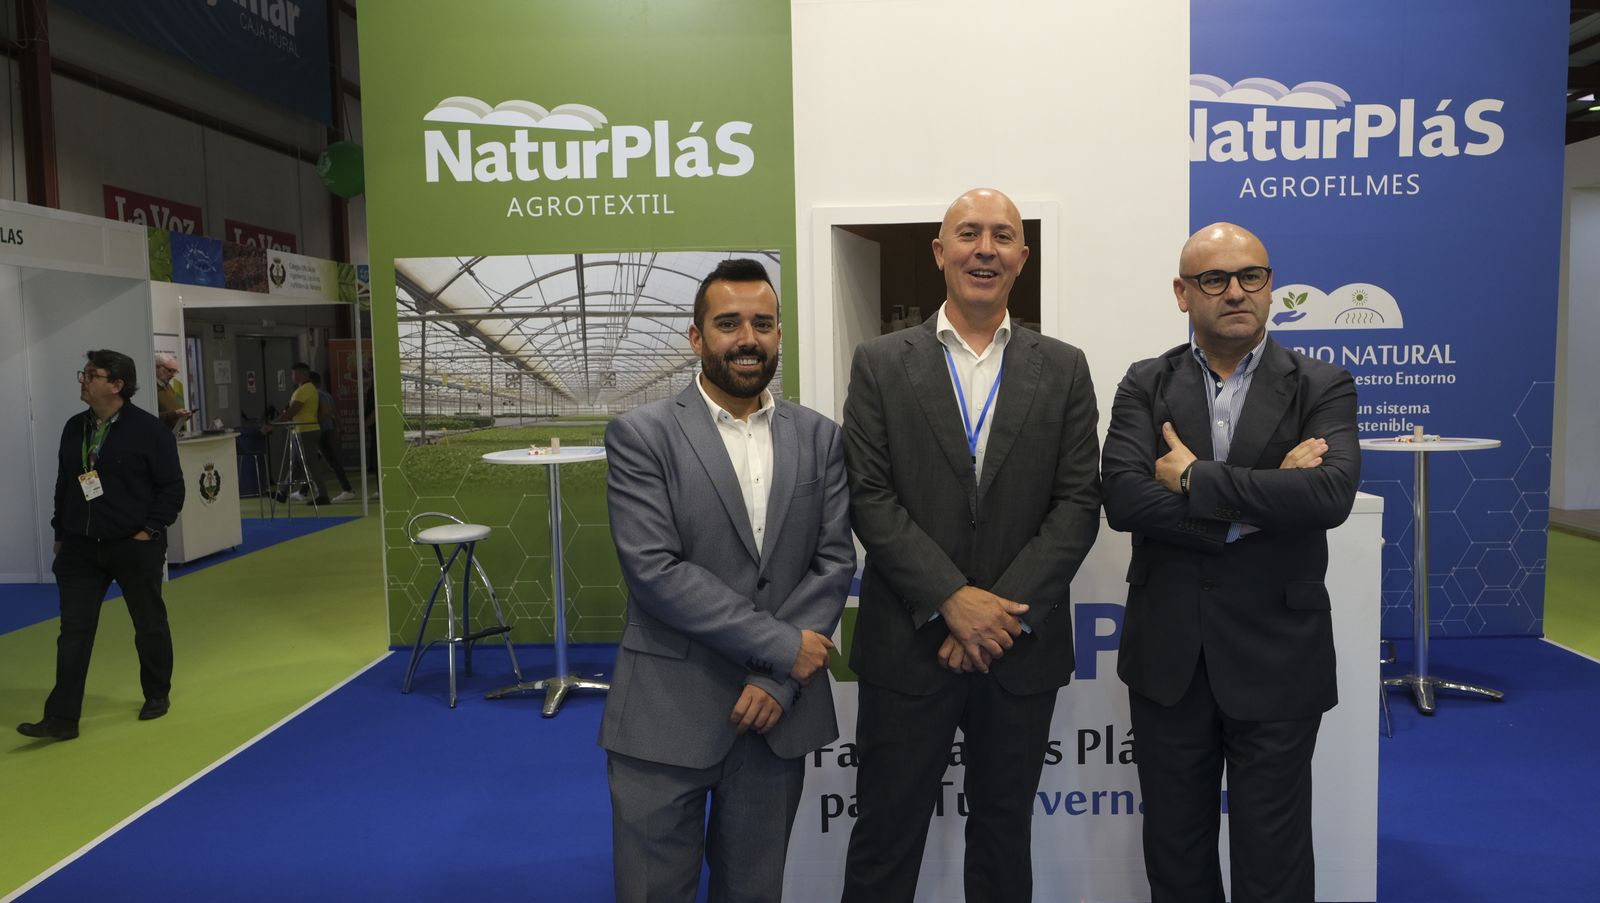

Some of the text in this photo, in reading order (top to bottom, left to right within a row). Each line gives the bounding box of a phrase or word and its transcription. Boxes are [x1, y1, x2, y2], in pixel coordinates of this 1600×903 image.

[1239, 173, 1421, 199] AGROFILMES
[506, 193, 675, 218] AGROTEXTIL
[1342, 345, 1456, 366] NATURAL
[1352, 372, 1456, 386] estro Entorno
[1375, 401, 1431, 416] sistema
